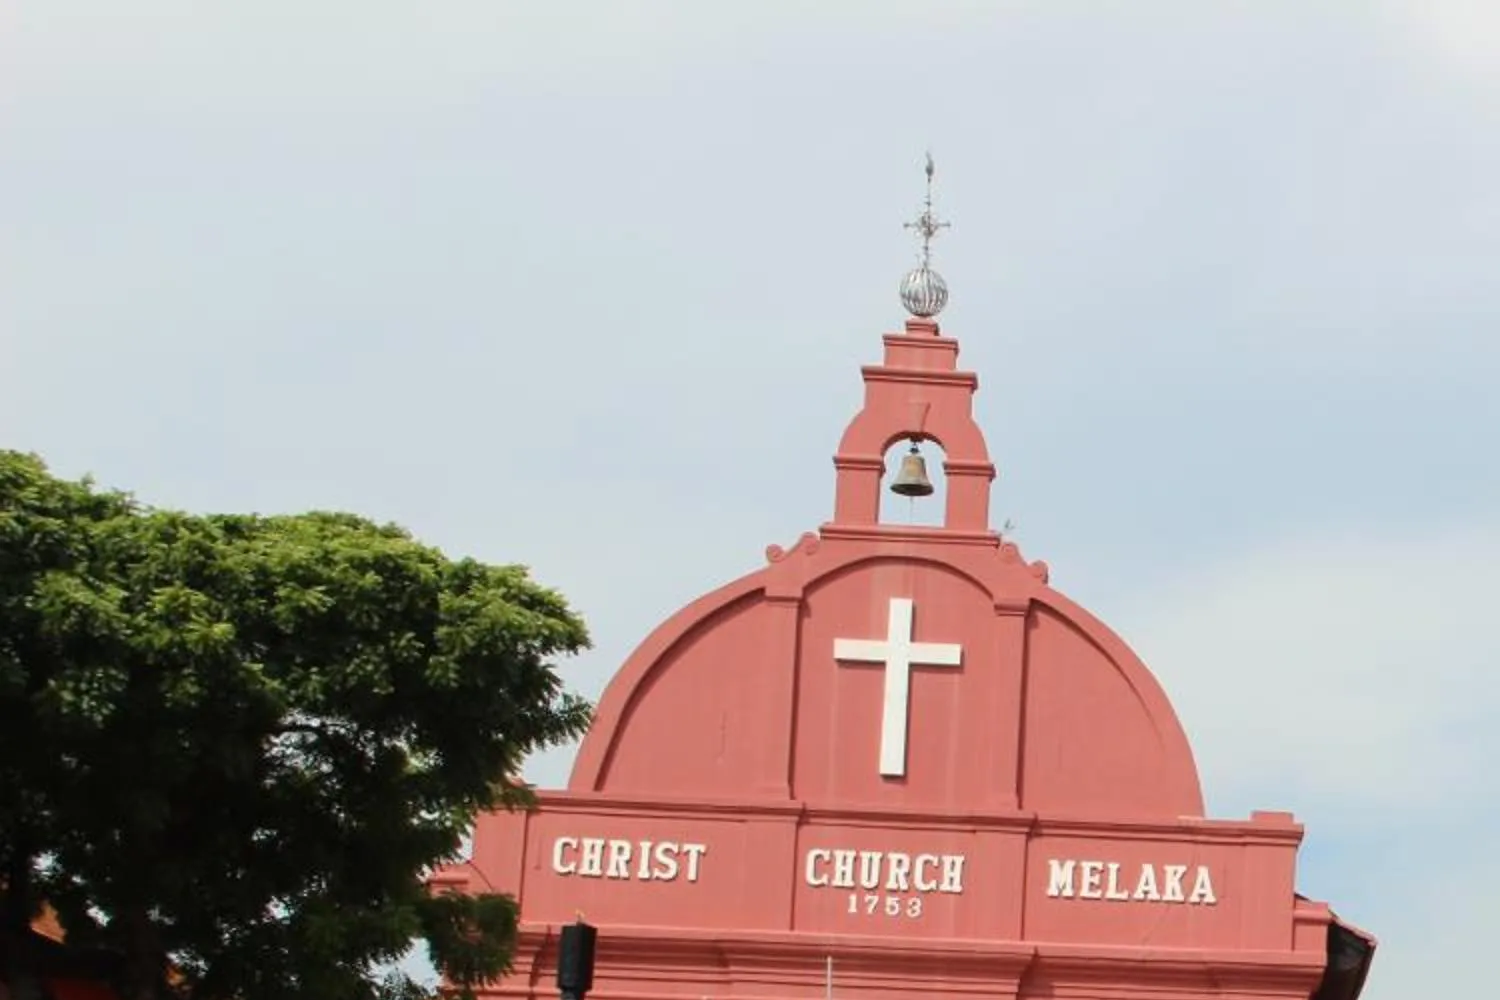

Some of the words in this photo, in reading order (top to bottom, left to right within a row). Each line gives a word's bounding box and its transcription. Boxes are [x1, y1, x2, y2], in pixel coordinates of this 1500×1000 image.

[552, 836, 706, 882] CHRIST
[805, 848, 965, 894] CHURCH
[1046, 859, 1217, 904] MELAKA
[847, 893, 922, 918] 1753
